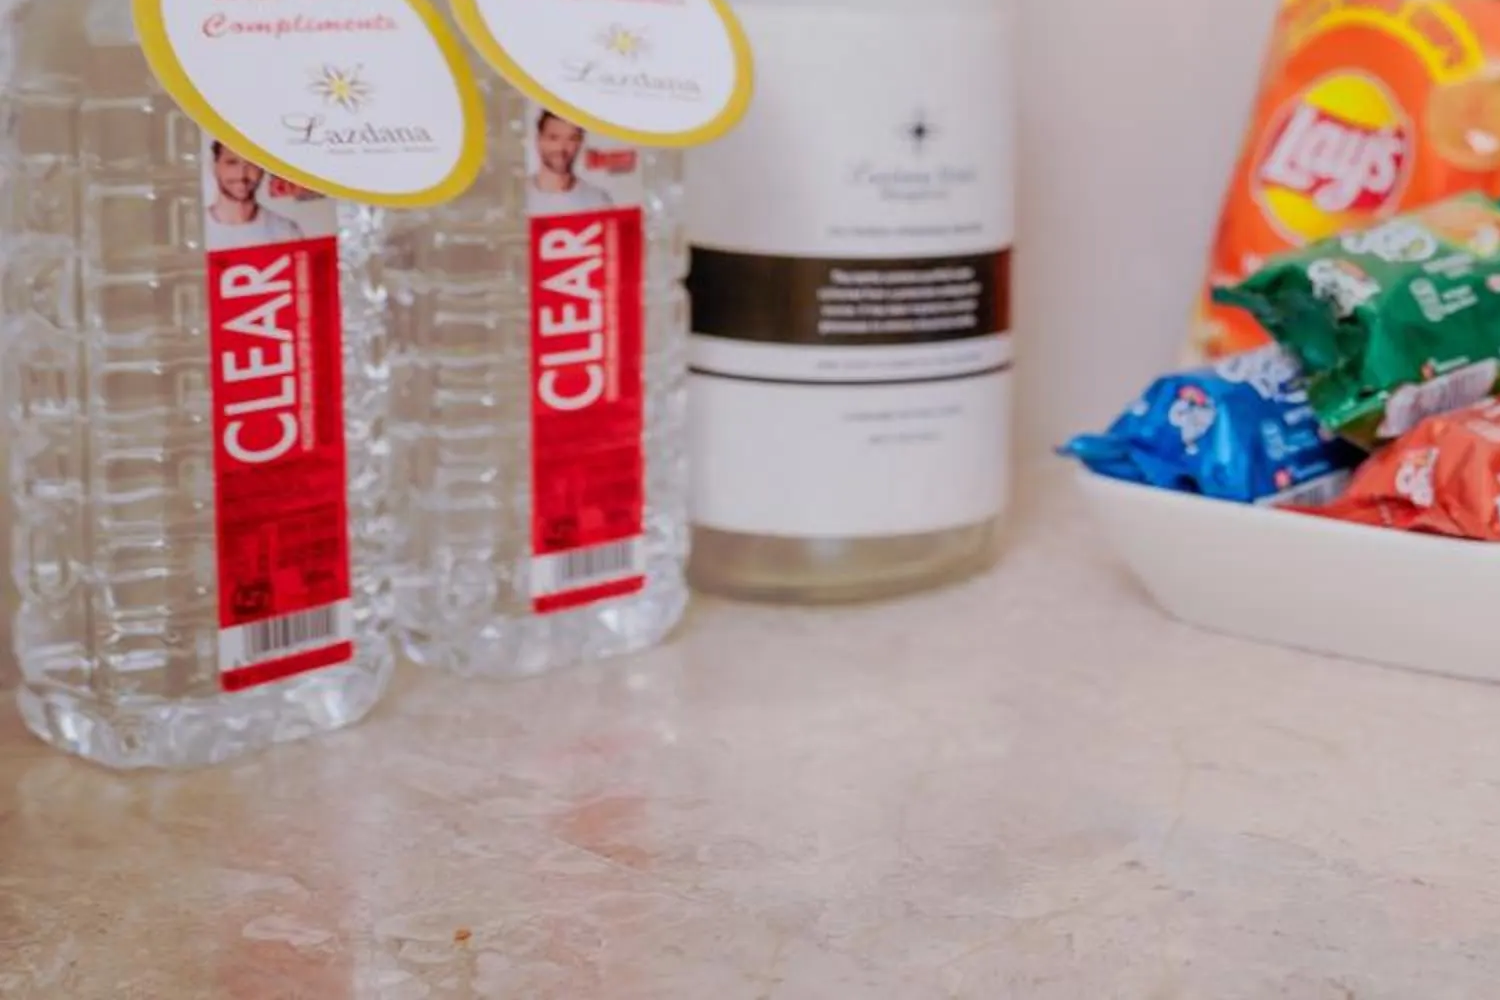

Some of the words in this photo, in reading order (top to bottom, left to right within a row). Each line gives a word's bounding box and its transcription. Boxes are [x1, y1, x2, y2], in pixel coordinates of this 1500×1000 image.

[202, 13, 397, 38] Compliments
[281, 113, 434, 145] Lazdana
[221, 255, 298, 462] CLEAR
[538, 222, 604, 411] CLEAR
